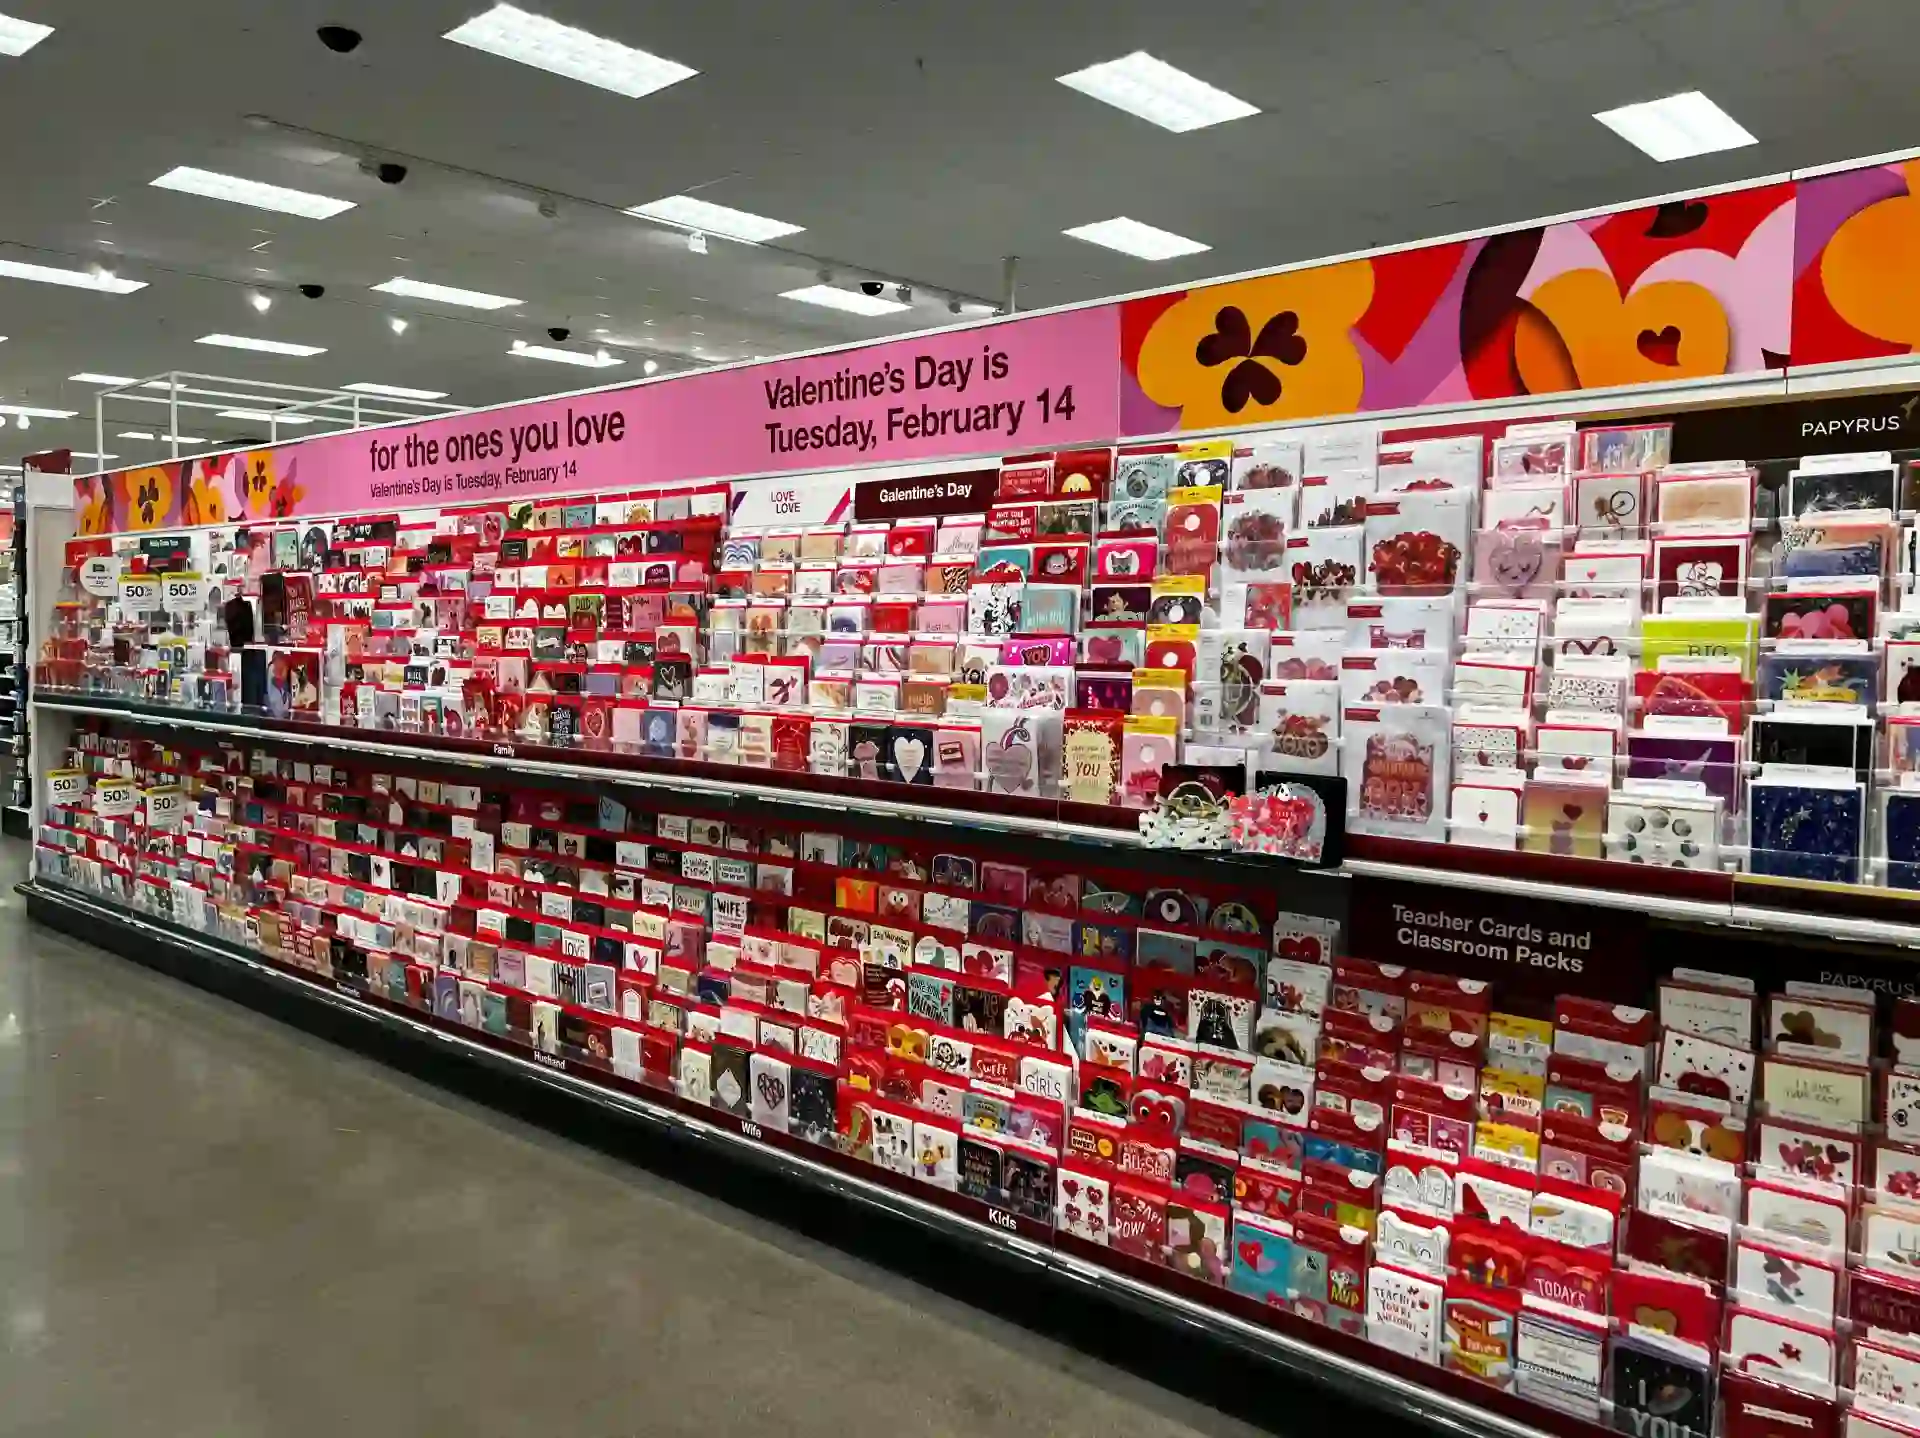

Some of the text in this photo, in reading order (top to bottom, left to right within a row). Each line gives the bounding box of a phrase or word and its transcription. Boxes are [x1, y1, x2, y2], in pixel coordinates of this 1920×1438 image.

[765, 345, 1009, 409] Valentine's Day is
[765, 385, 1075, 453] Tuesday, February 14
[1801, 416, 1900, 436] PAPYRUS
[370, 408, 625, 472] for the ones you love
[370, 459, 577, 498] Valentine's Day is Tuesday, February 14
[771, 491, 795, 503] LOVE
[879, 482, 973, 503] Galentine's Day
[776, 503, 801, 514] LOVE
[126, 585, 144, 598] 50
[169, 584, 188, 596] 50
[1024, 649, 1049, 663] YOU
[493, 743, 515, 757] Family
[1076, 762, 1100, 777] YOU
[53, 780, 71, 791] 50
[103, 790, 121, 802] 50
[153, 798, 171, 810] 50
[1392, 904, 1591, 950] Teacher Cards and
[1398, 928, 1584, 973] Classroom Packs
[1820, 970, 1915, 996] PAPYRUS
[534, 1051, 566, 1070] Husband
[1025, 1074, 1062, 1099] GIRLS
[741, 1121, 762, 1139] Wife
[988, 1208, 1017, 1231] Kids
[1115, 1217, 1145, 1238] POW!
